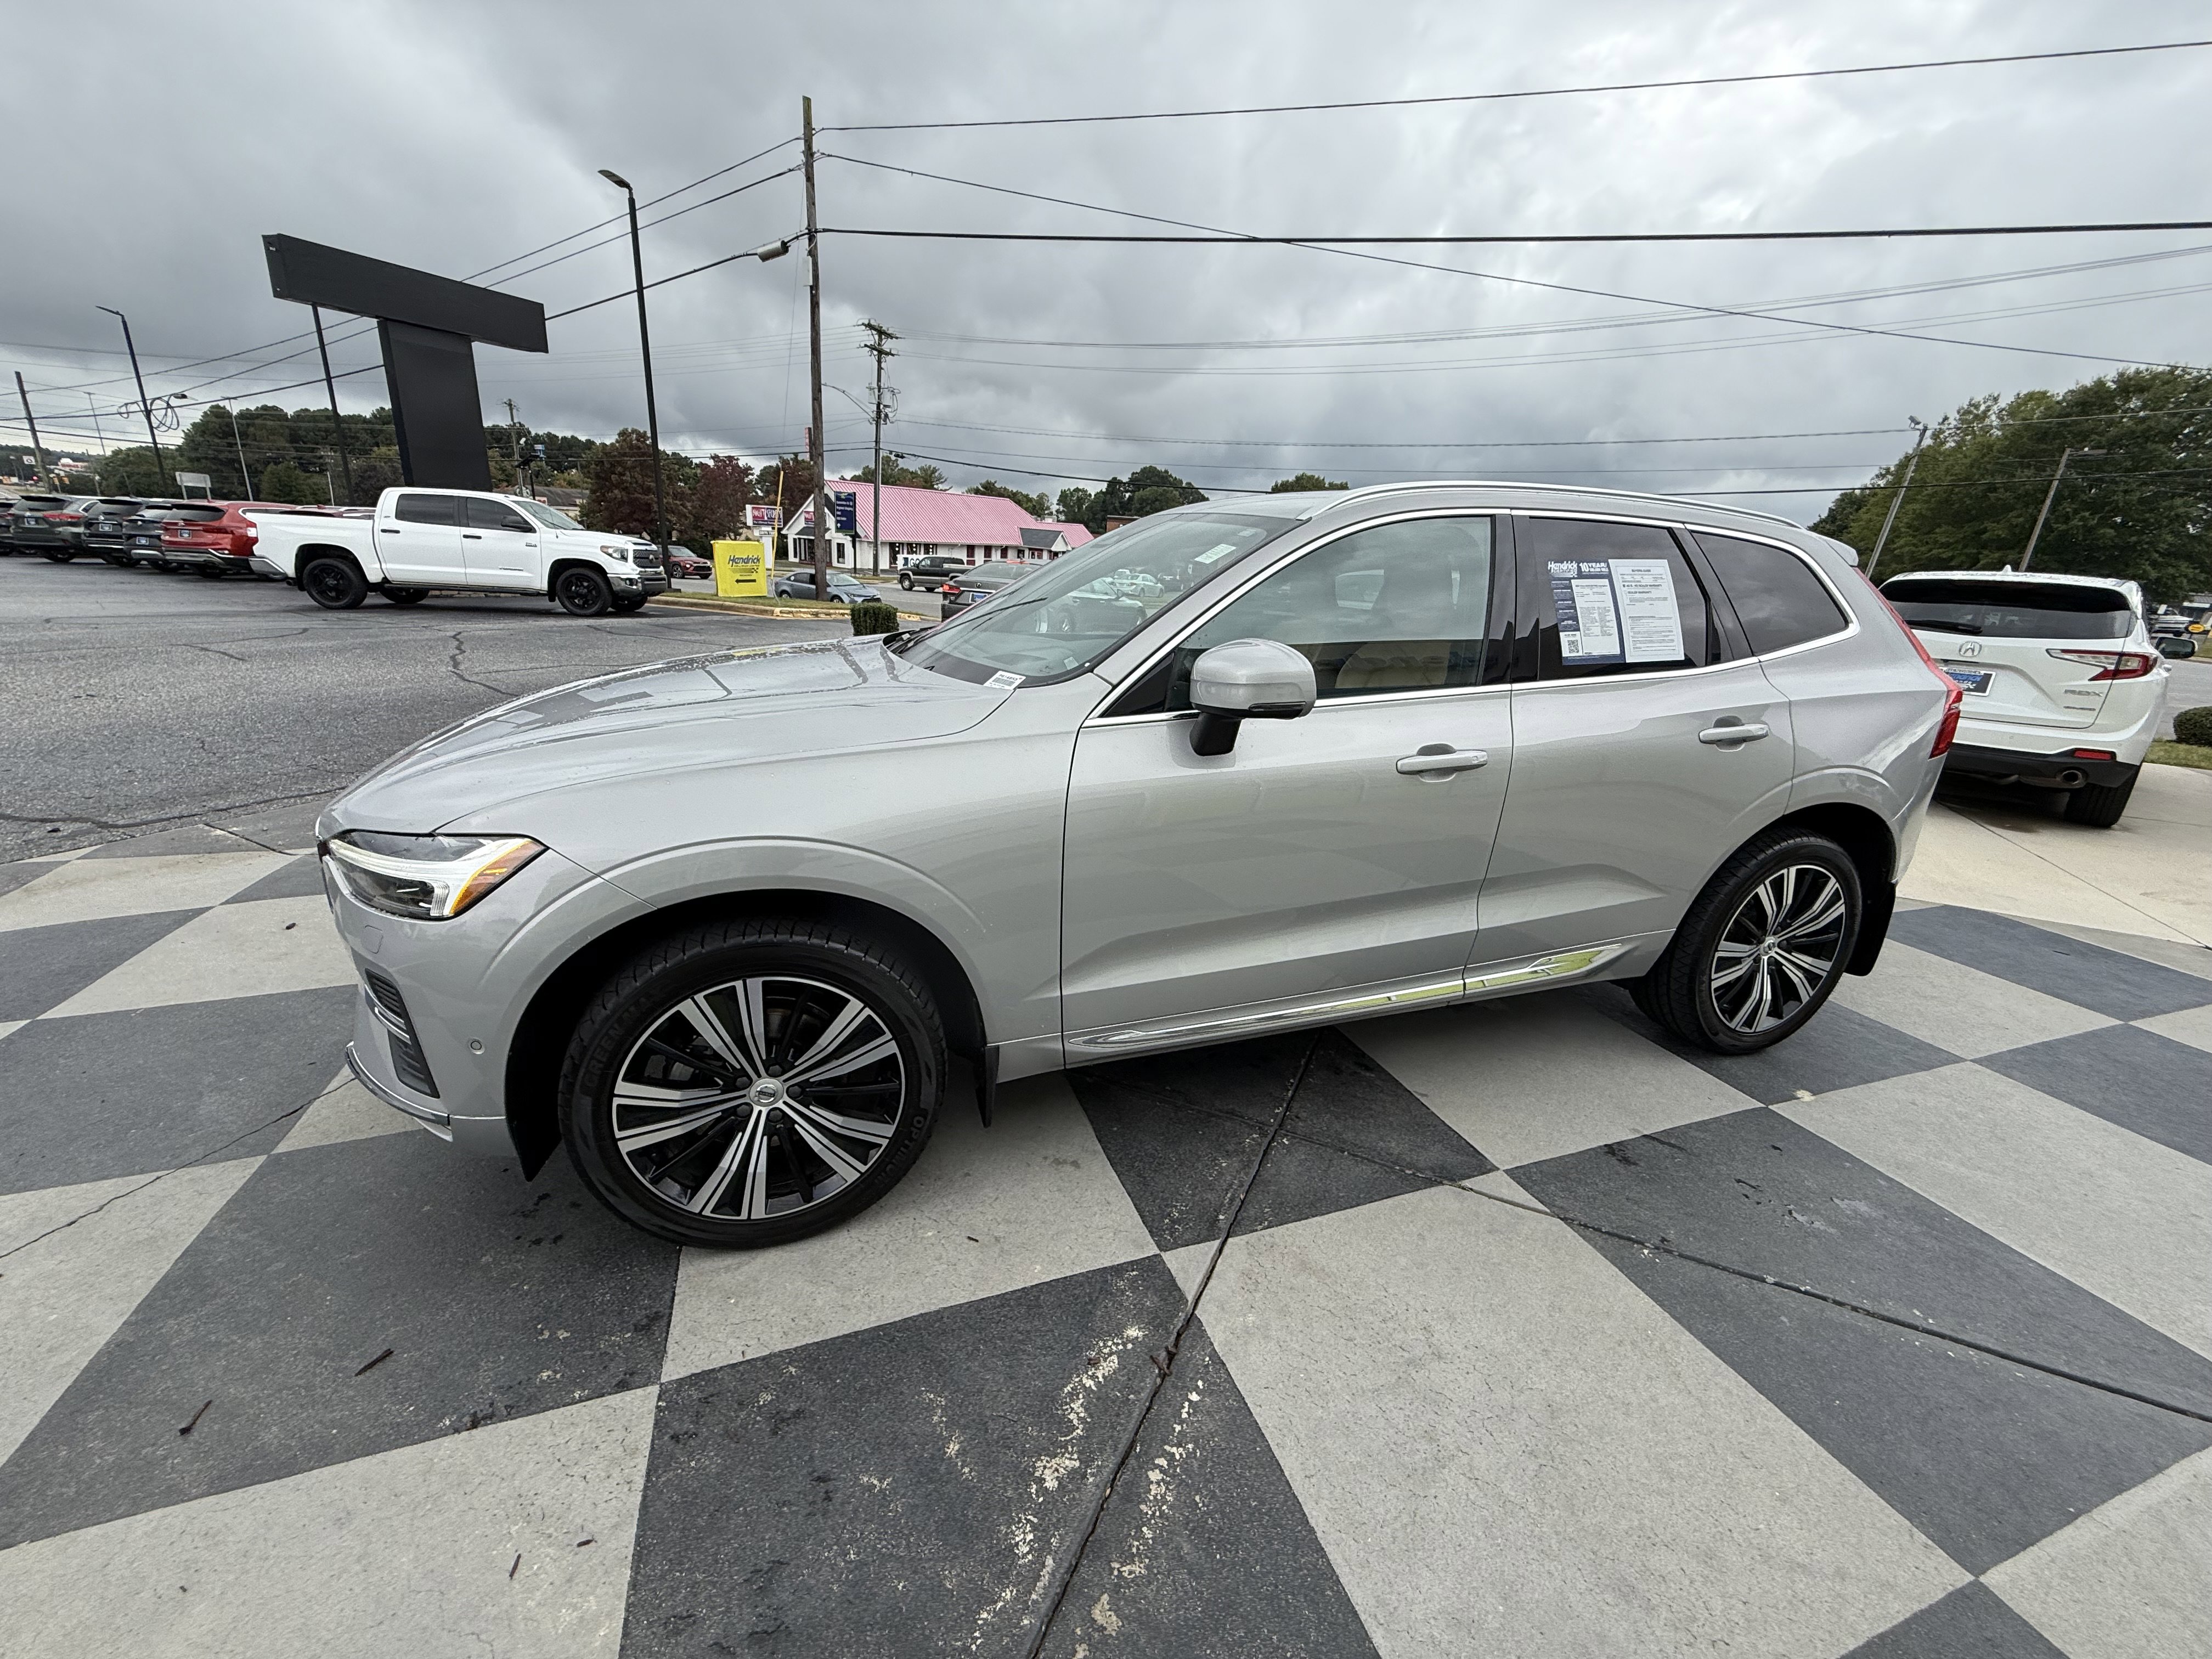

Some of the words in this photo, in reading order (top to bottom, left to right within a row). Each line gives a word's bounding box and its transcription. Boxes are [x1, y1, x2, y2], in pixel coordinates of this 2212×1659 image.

[727, 555, 761, 567] Hendrick
[1548, 561, 1578, 573] Hendrick
[1579, 562, 1589, 572] 10
[2064, 689, 2103, 697] RDX
